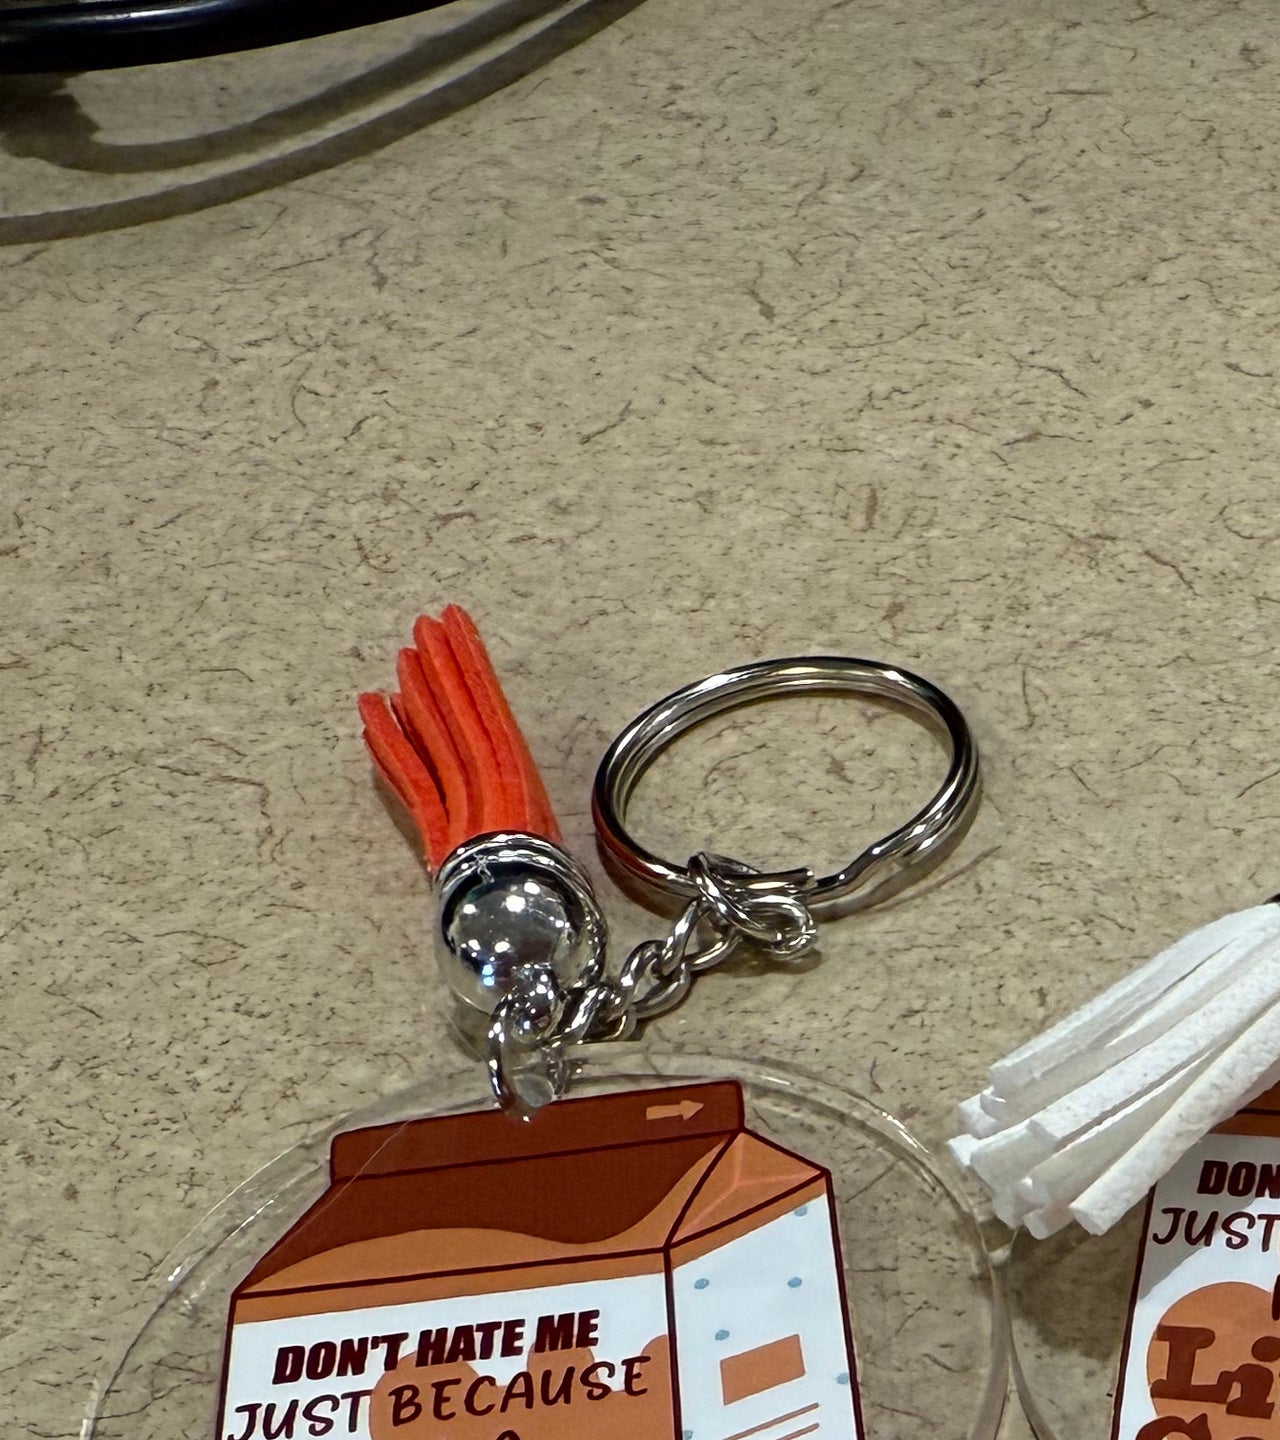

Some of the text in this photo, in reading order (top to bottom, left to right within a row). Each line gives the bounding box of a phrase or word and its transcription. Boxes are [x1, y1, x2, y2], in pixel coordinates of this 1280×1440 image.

[272, 1309, 600, 1385] DON'T HATE ME
[390, 1356, 651, 1427] BECAUSE
